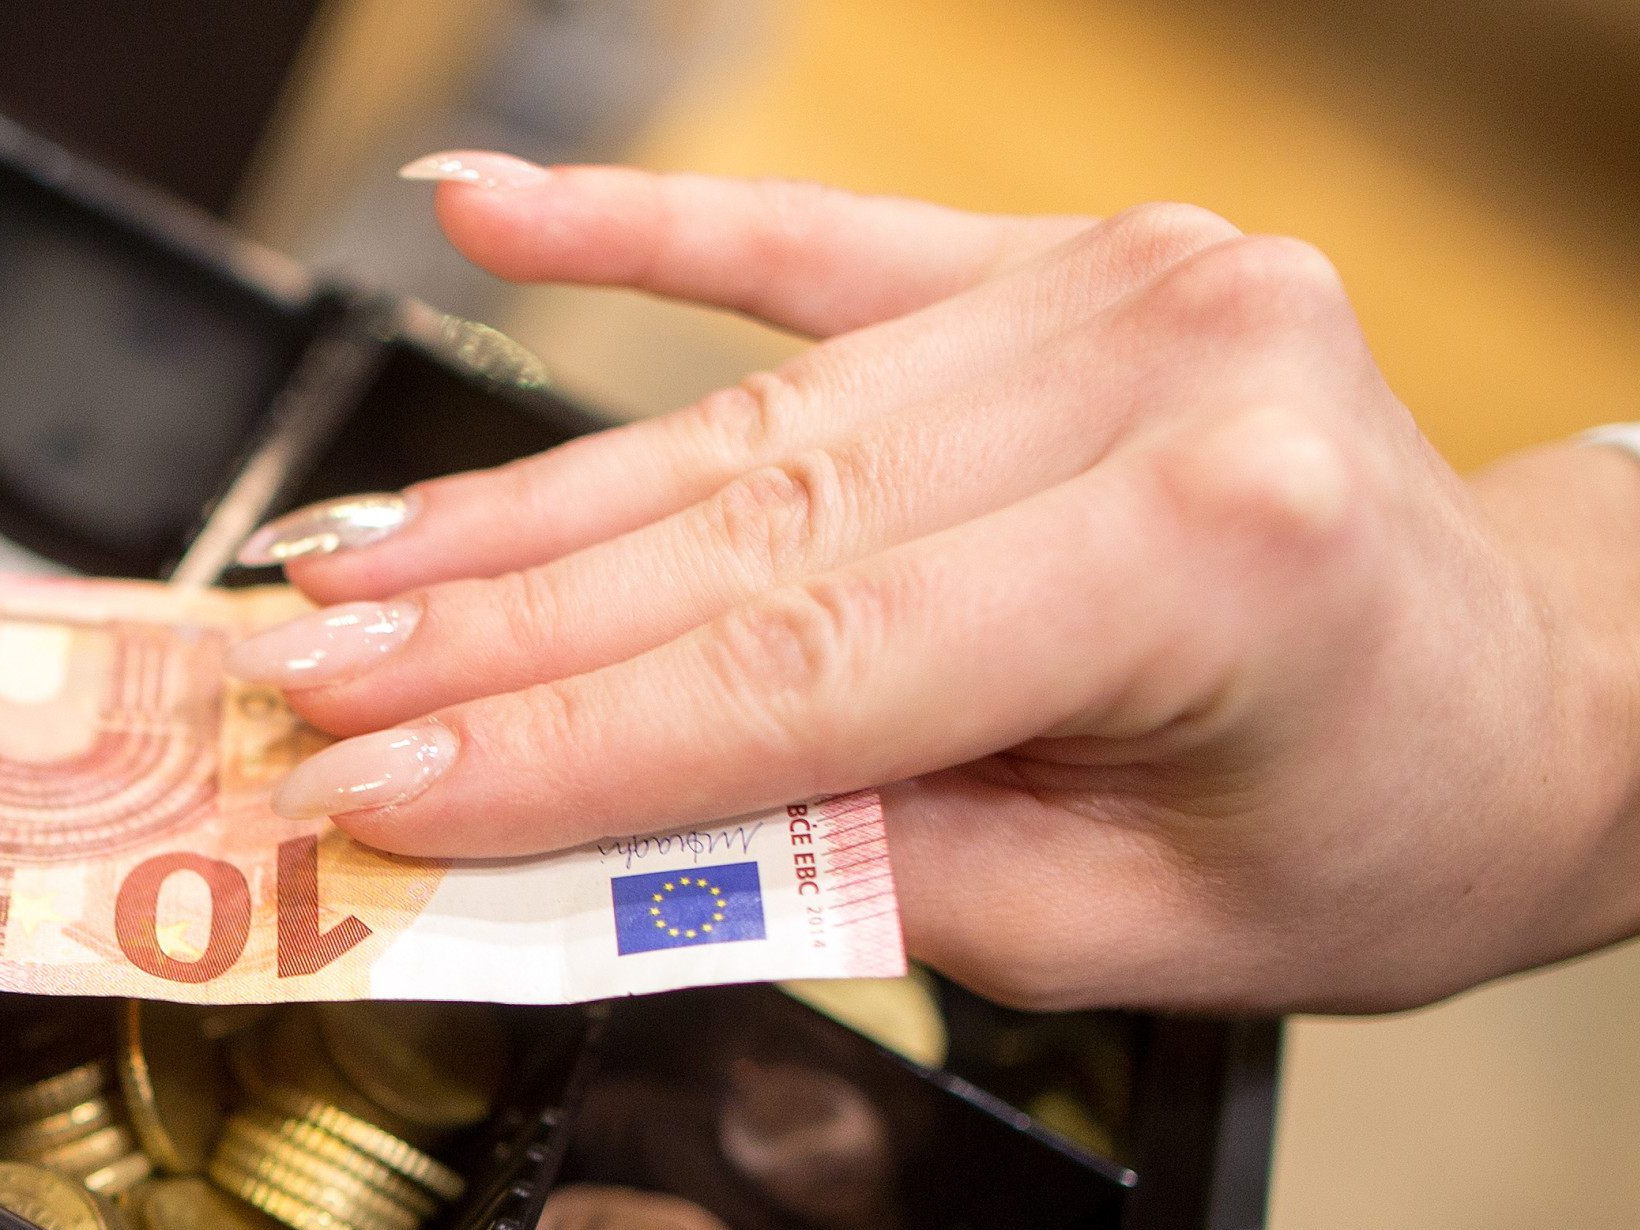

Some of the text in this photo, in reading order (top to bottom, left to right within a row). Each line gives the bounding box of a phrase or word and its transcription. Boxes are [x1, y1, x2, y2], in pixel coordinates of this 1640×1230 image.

[114, 833, 373, 984] 10
[794, 853, 820, 896] EBC
[807, 906, 827, 949] 2014
